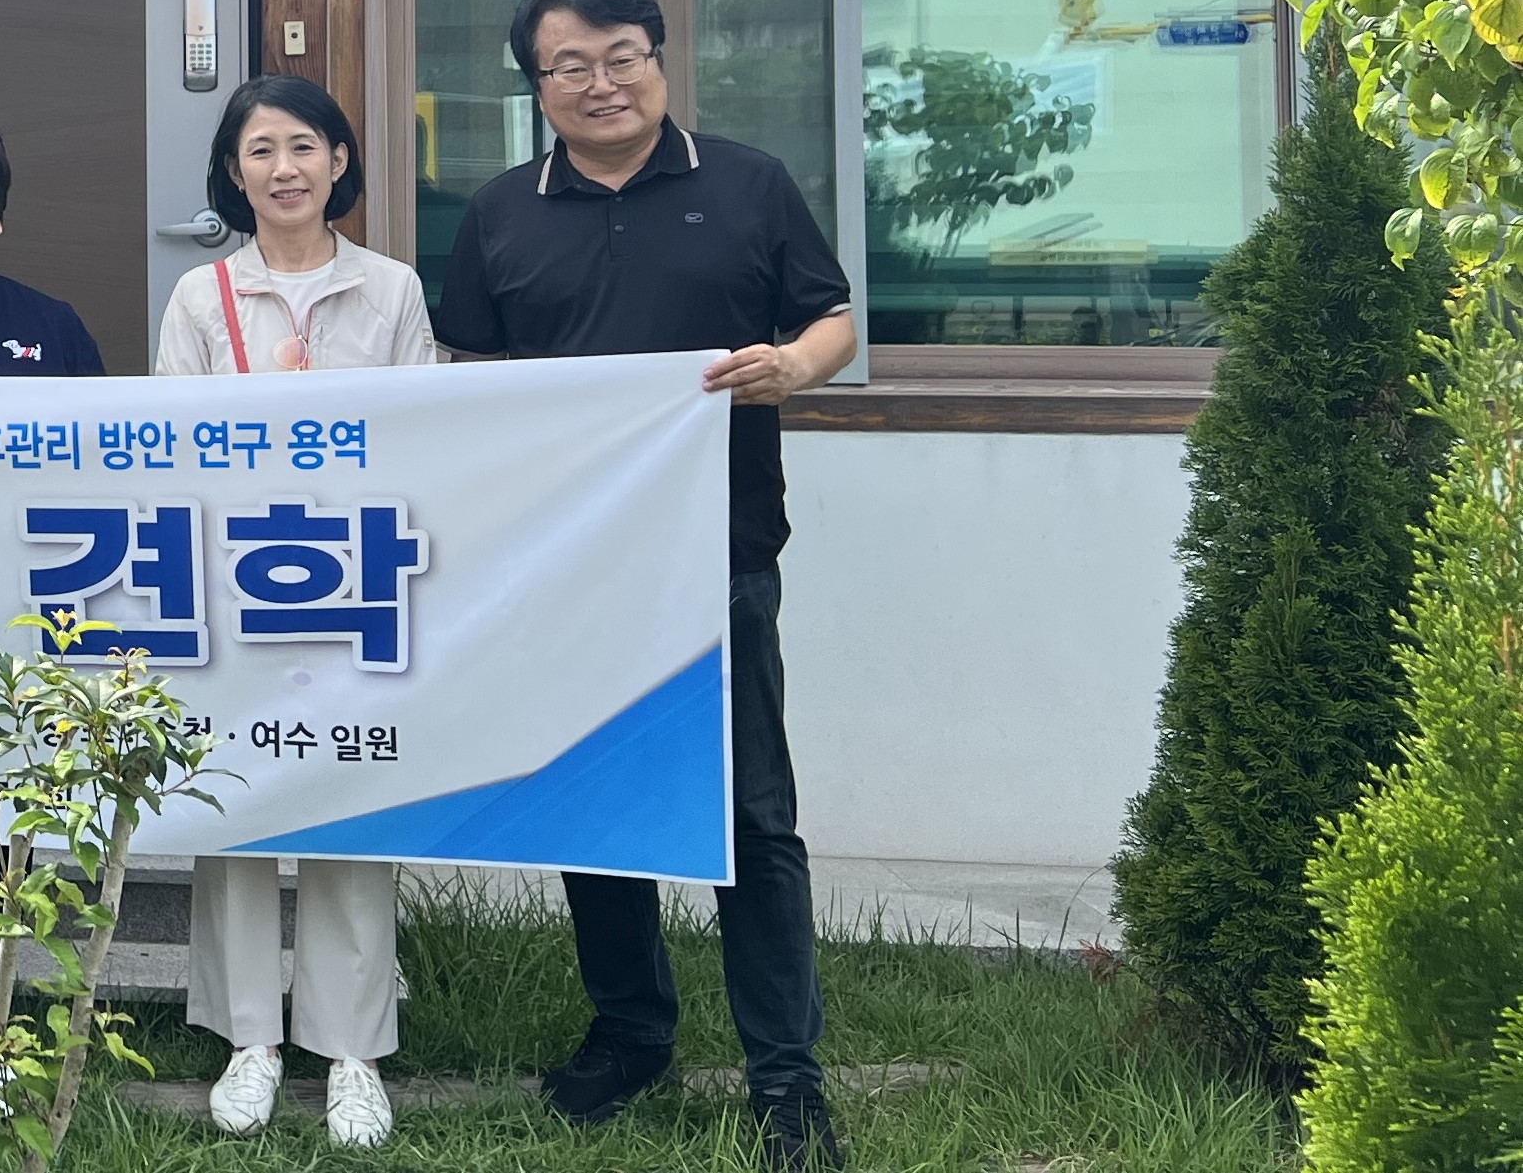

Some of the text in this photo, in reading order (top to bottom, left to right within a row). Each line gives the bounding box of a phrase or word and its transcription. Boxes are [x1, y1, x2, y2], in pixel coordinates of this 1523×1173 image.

[98, 420, 177, 470] 방안
[193, 420, 272, 469] 연구
[287, 419, 367, 470] 용역
[25, 503, 419, 664] 견학
[251, 719, 319, 759] 여수
[330, 724, 399, 763] 일원
